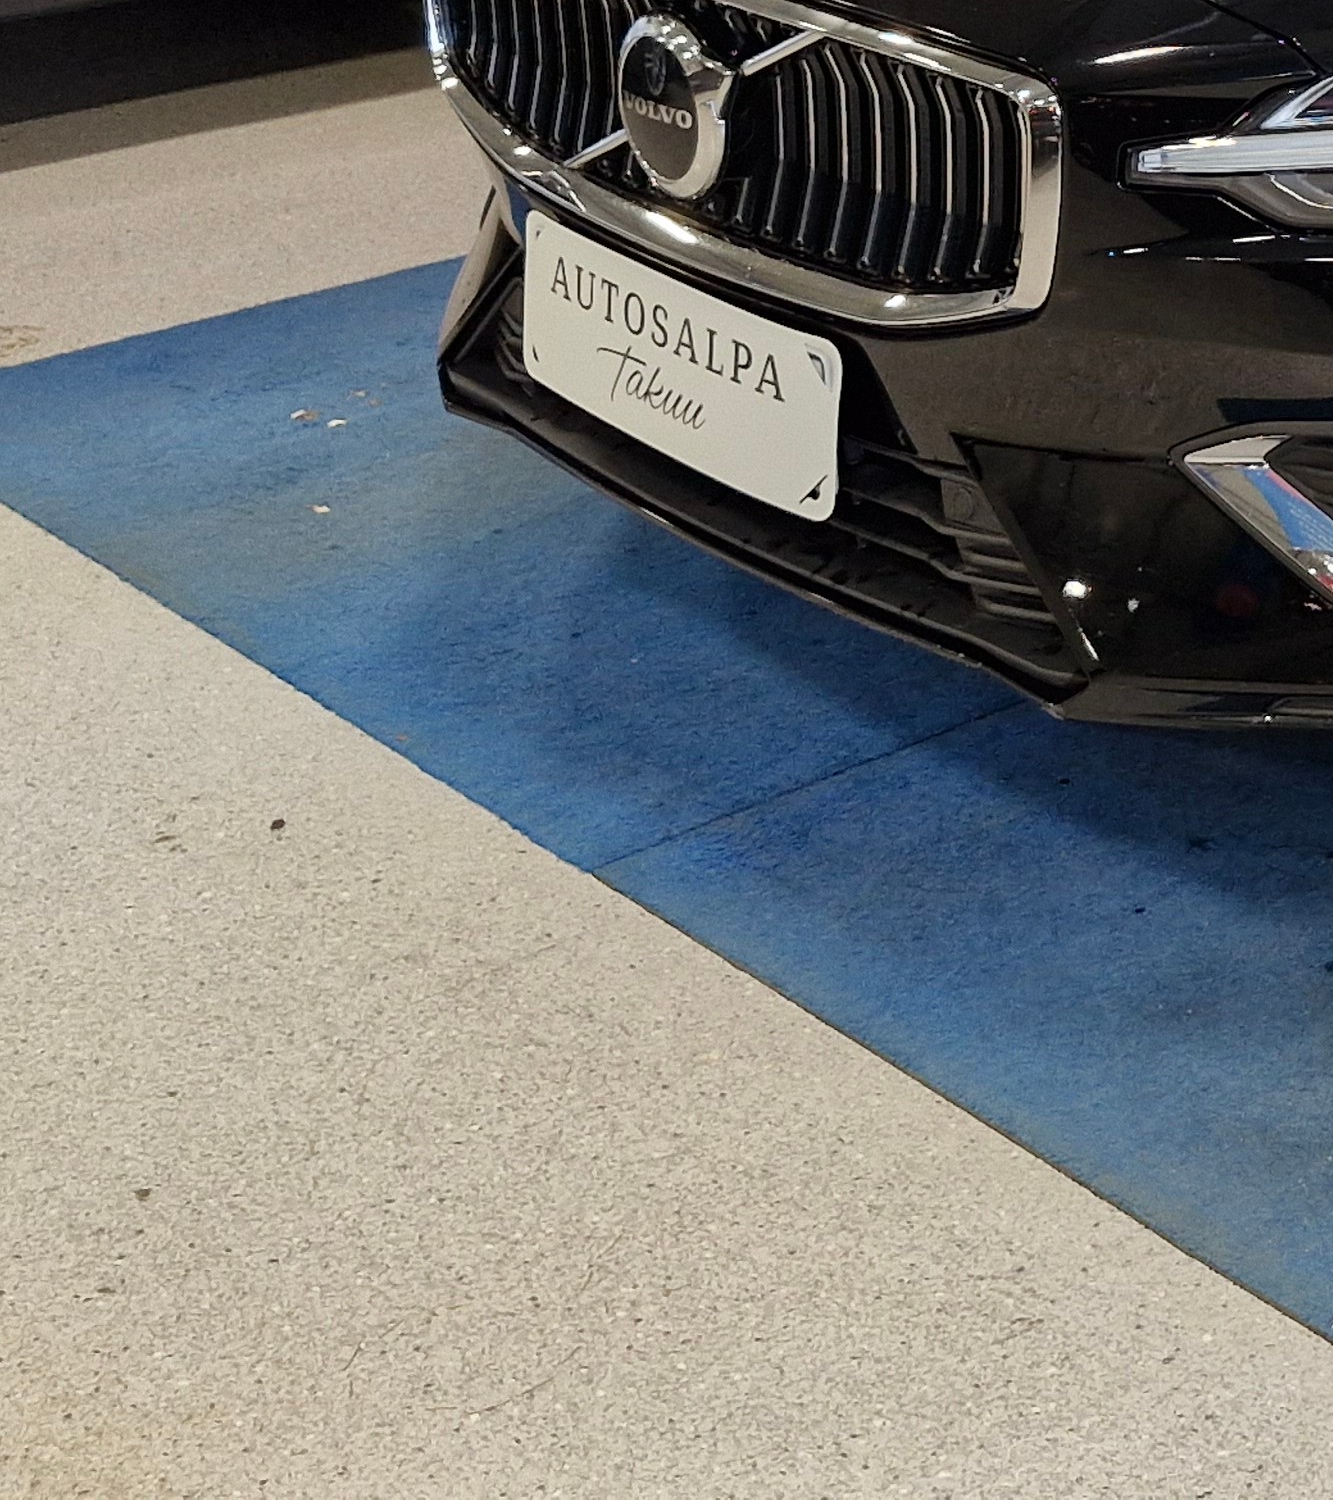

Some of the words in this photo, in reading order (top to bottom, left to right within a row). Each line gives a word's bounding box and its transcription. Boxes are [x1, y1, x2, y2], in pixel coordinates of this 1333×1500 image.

[622, 88, 693, 130] VOLVO
[550, 256, 786, 403] AUTOSALPA
[596, 345, 706, 430] Takuu
